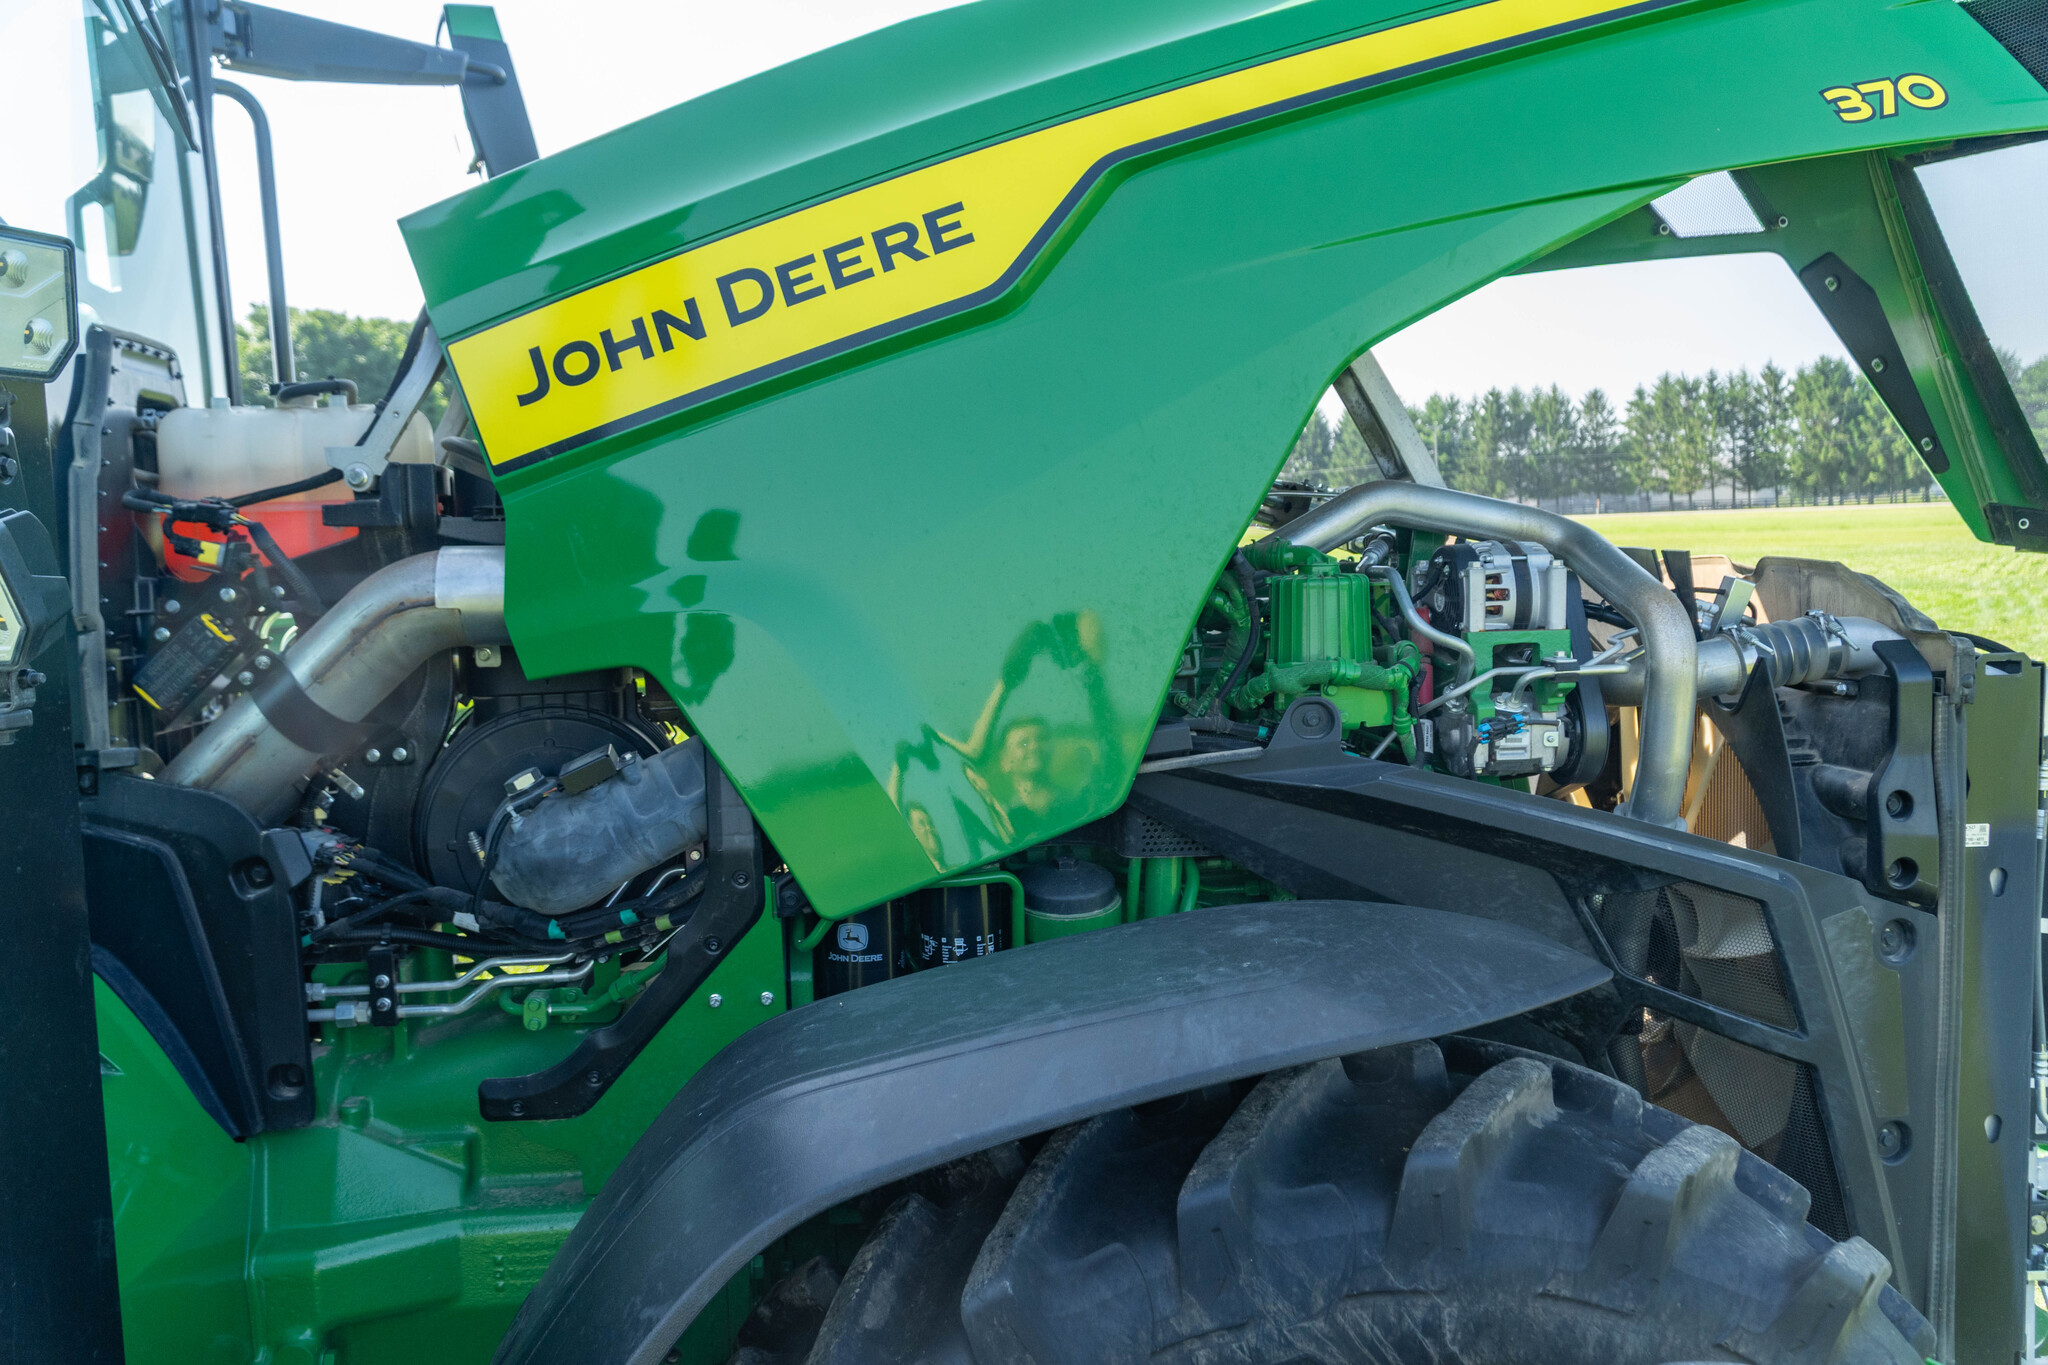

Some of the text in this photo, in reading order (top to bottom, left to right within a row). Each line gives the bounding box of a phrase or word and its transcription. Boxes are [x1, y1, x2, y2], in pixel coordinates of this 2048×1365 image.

[1819, 72, 1949, 124] 370
[516, 201, 976, 407] JOHN DEERE
[828, 951, 883, 963] JOHN DEERE
